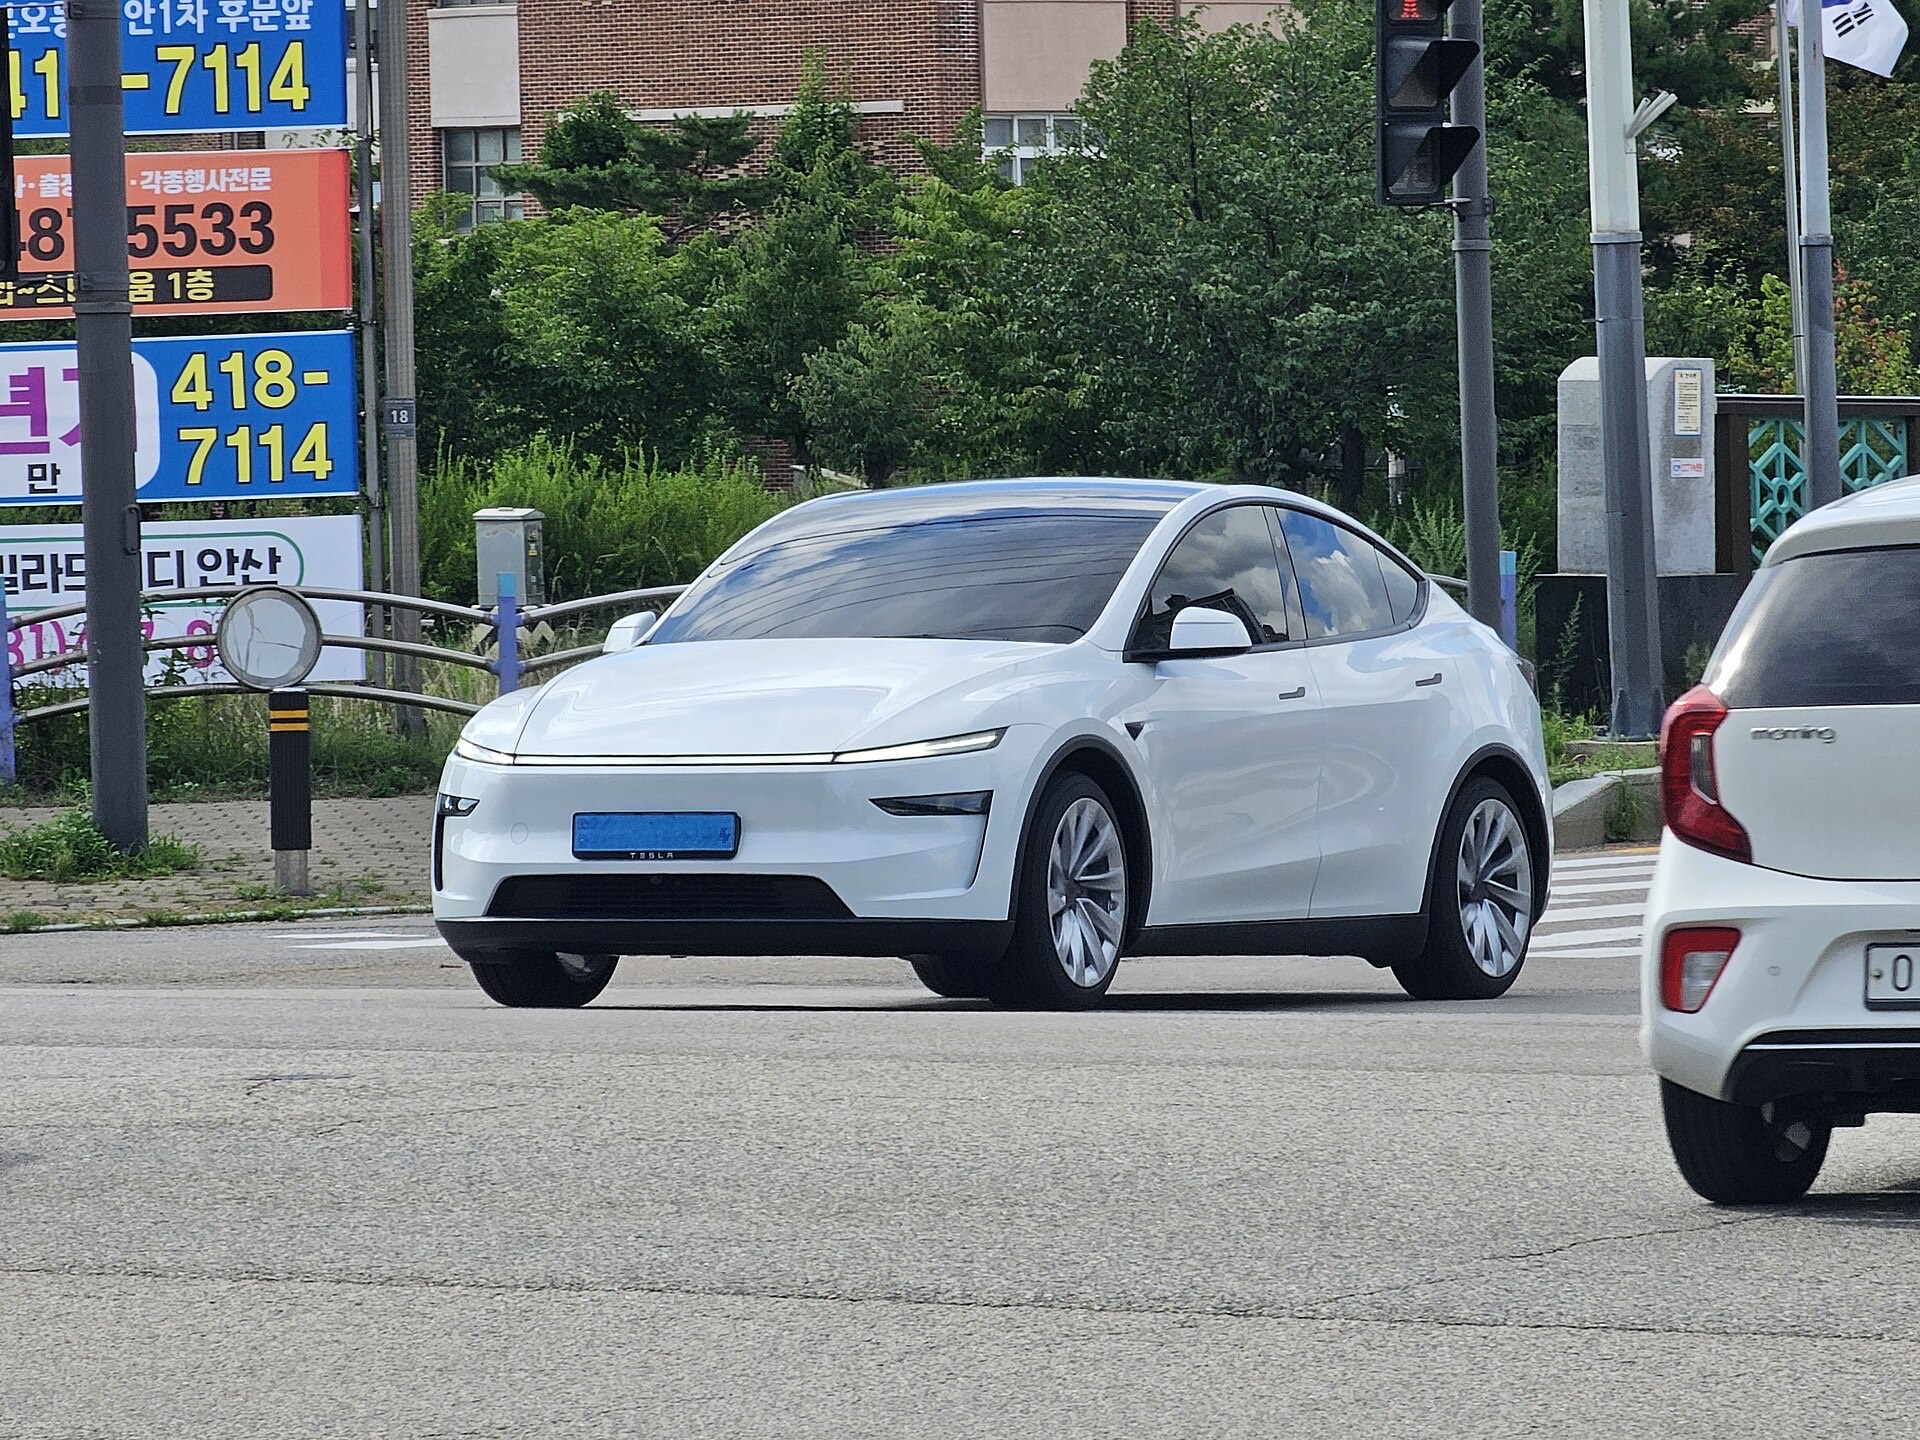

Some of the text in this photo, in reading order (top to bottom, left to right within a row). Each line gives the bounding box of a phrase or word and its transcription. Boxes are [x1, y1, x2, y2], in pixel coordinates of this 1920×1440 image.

[167, 269, 214, 301] 1층
[171, 349, 330, 411] 418-
[391, 409, 409, 424] 18
[179, 422, 333, 485] 7114
